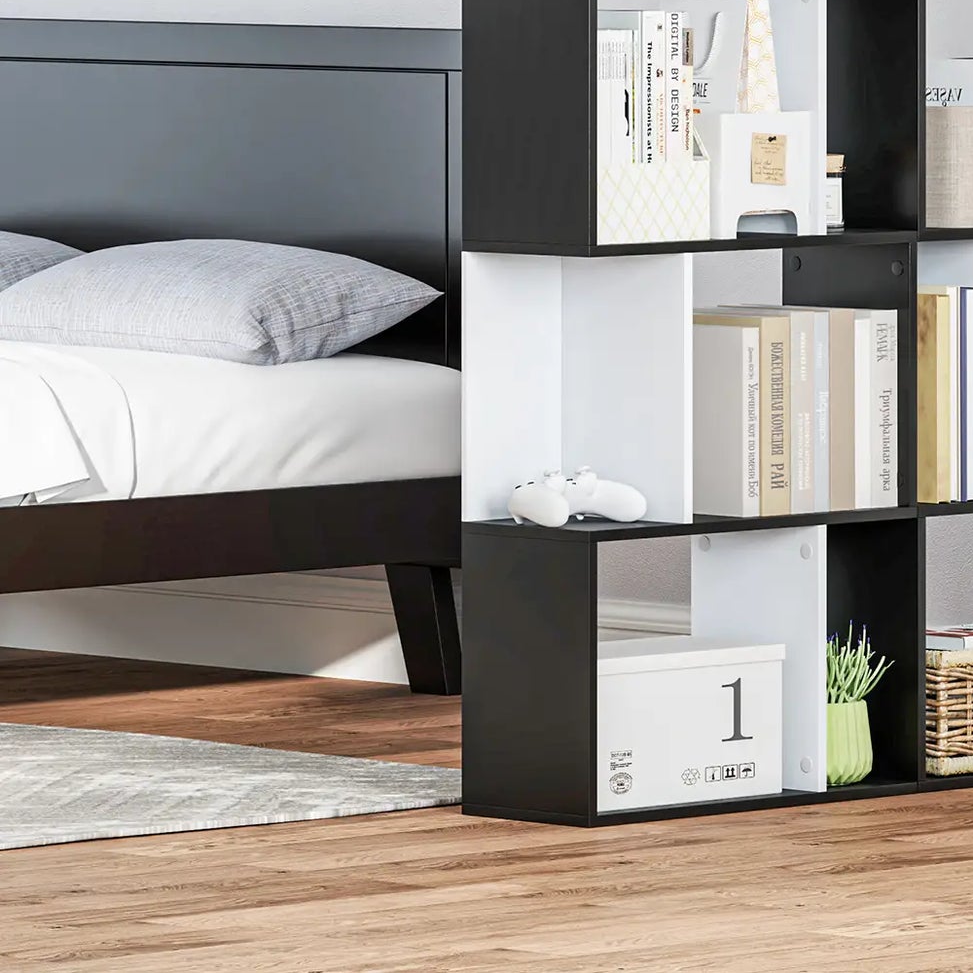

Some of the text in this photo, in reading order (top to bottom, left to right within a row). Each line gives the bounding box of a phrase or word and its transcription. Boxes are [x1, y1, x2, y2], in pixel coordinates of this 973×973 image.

[671, 13, 679, 133] DIGITAL BY DESIGN
[647, 142, 652, 150] at
[748, 382, 758, 422] Уличный
[771, 342, 784, 455] БОЖЕСТВЕННАЯ КОМЕДИЯ
[879, 388, 892, 492] Триумфальная арка
[748, 481, 758, 498] Боб
[771, 462, 788, 490] РАЙ
[721, 677, 753, 742] 1
